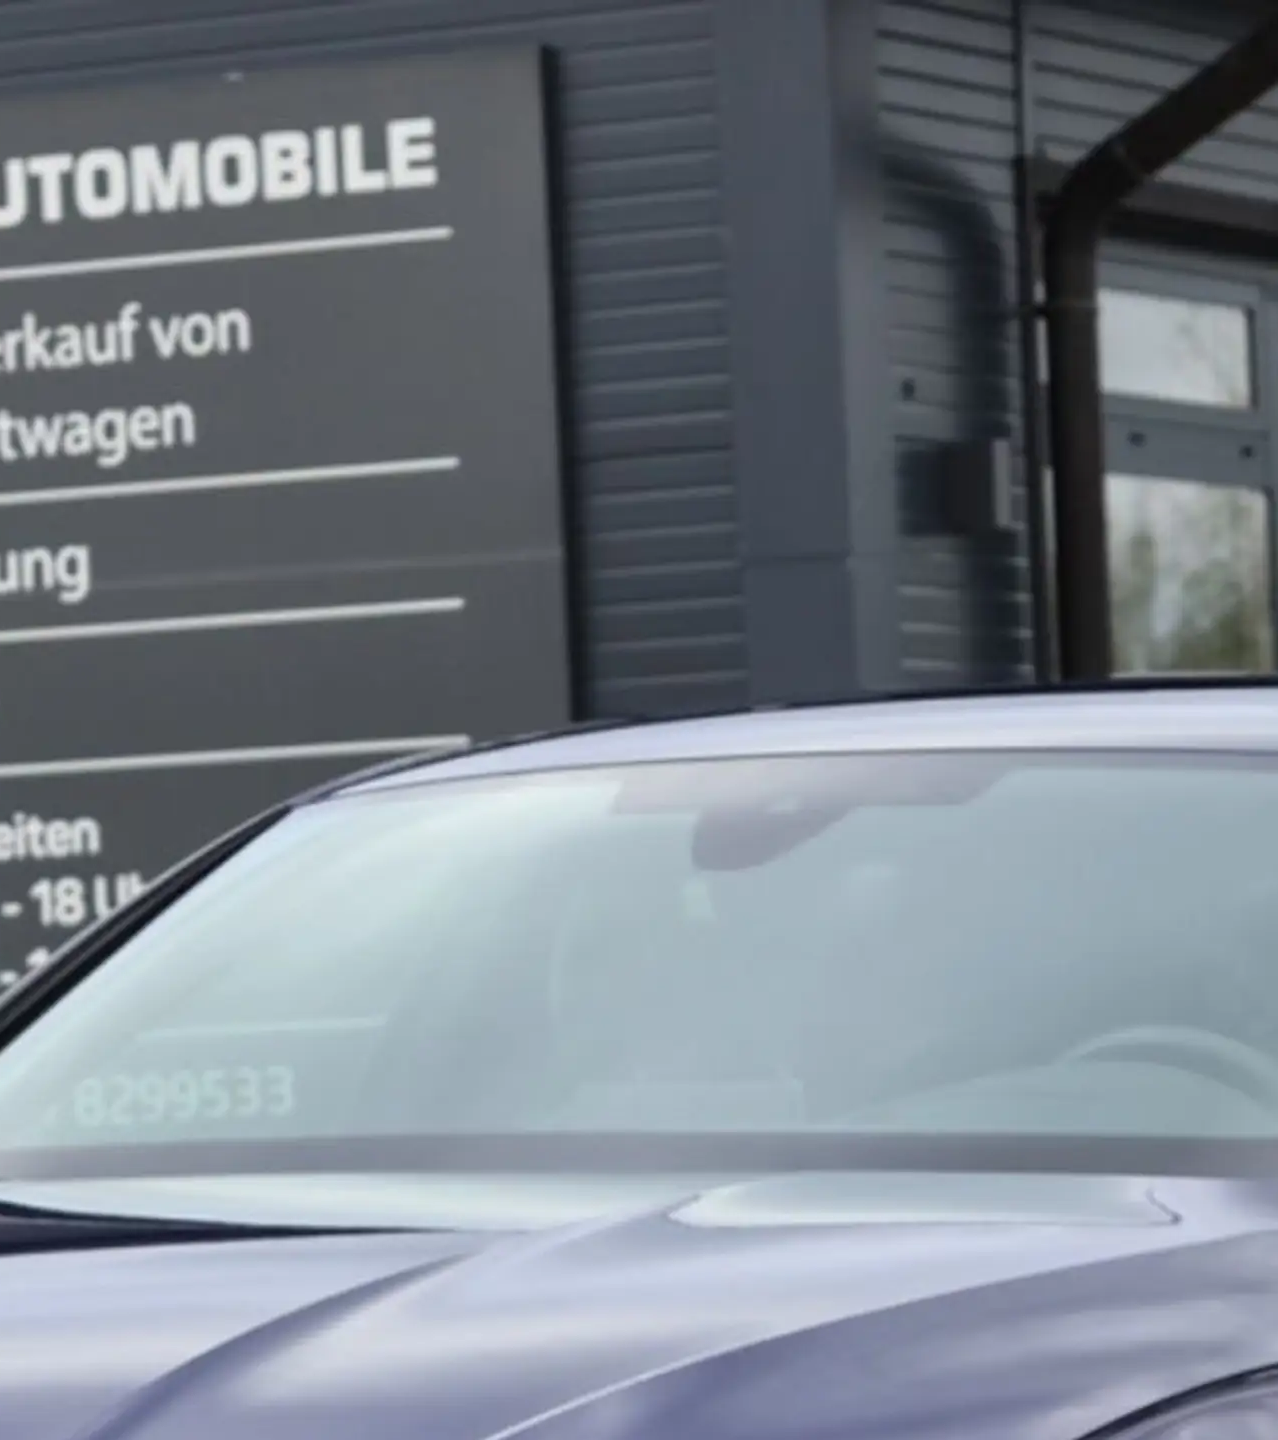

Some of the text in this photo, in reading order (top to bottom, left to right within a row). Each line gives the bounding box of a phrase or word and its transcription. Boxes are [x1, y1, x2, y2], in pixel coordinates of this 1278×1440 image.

[150, 309, 251, 357] von
[29, 875, 84, 927] 18
[74, 1066, 296, 1126] 8299533
